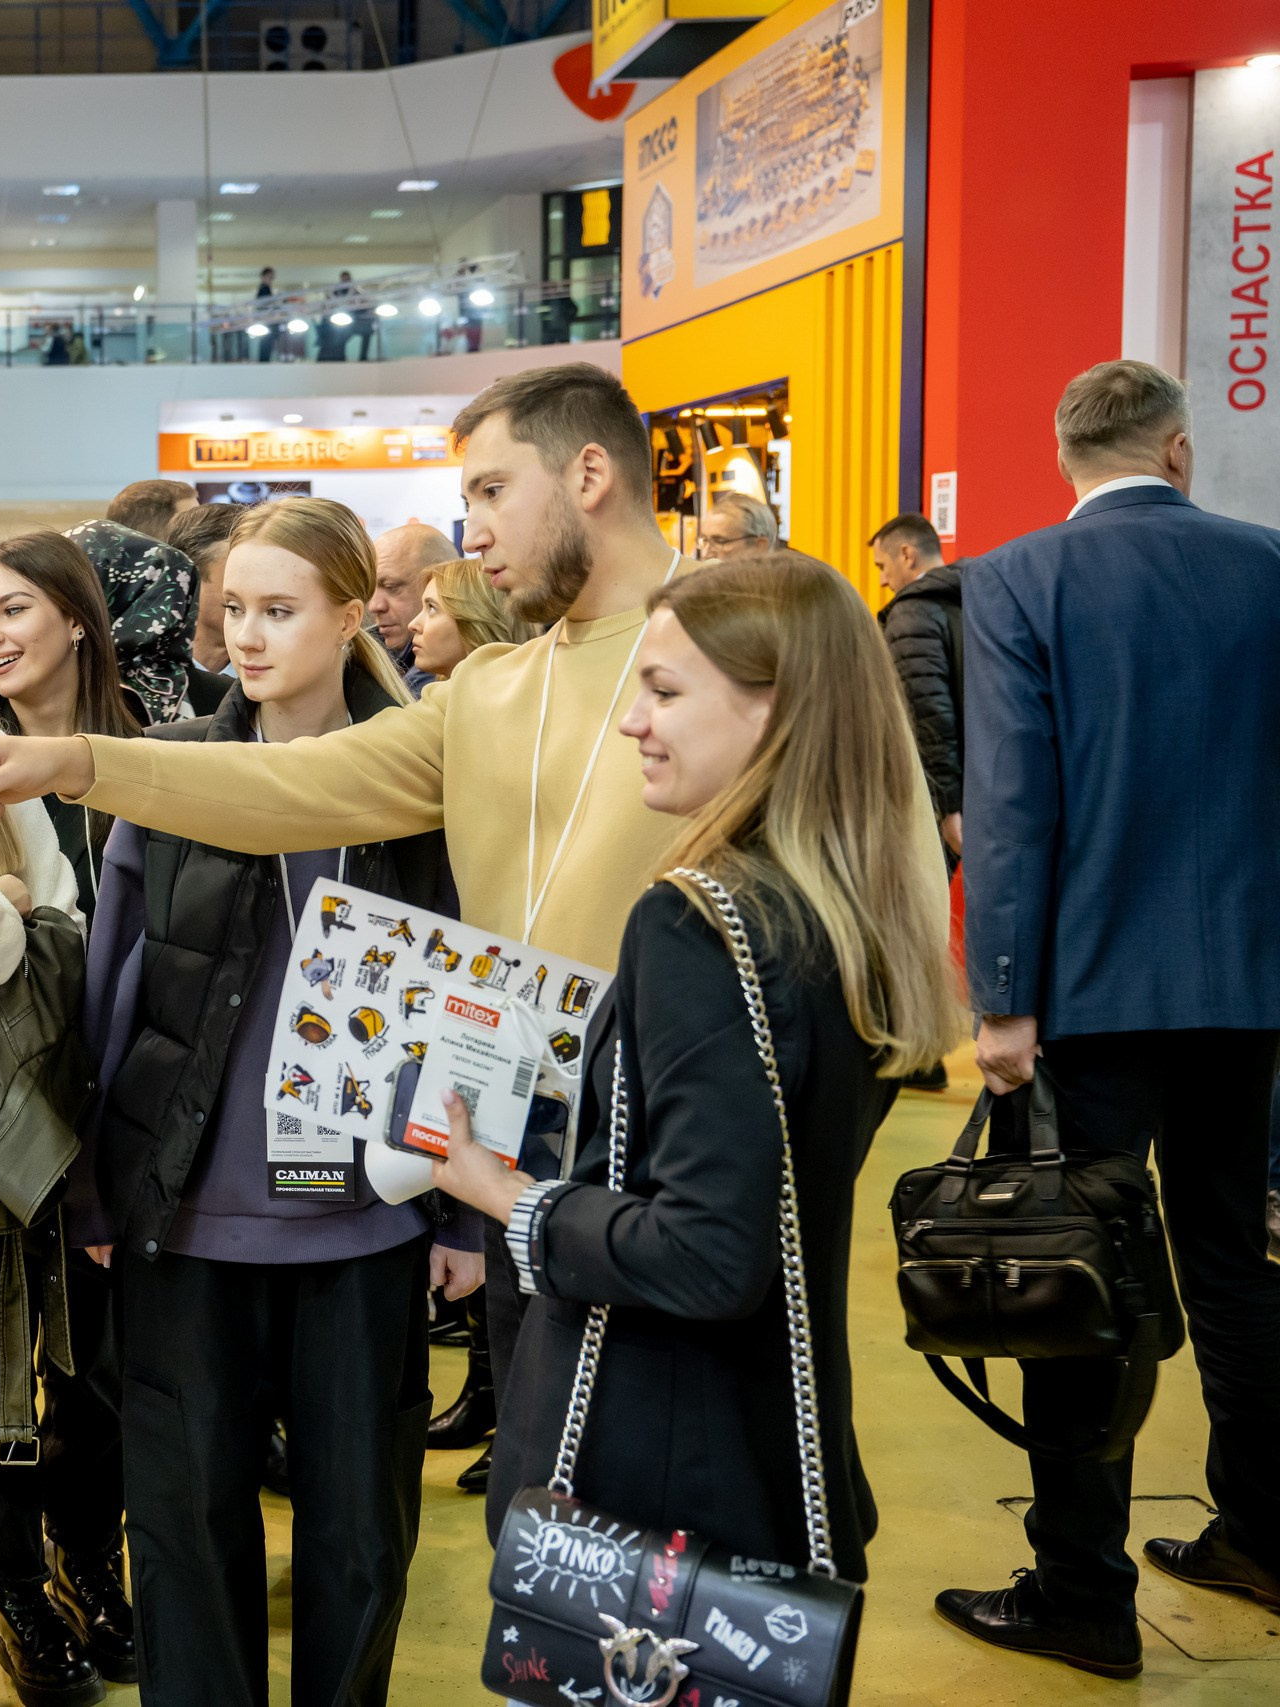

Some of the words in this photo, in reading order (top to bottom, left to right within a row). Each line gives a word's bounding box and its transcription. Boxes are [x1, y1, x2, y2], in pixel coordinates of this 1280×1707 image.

[1227, 150, 1274, 412] ОСНАСТКА
[447, 998, 496, 1026] mitex
[275, 1169, 345, 1181] CAIMAN
[540, 1526, 617, 1576] PINKO
[502, 1647, 551, 1684] SHINE
